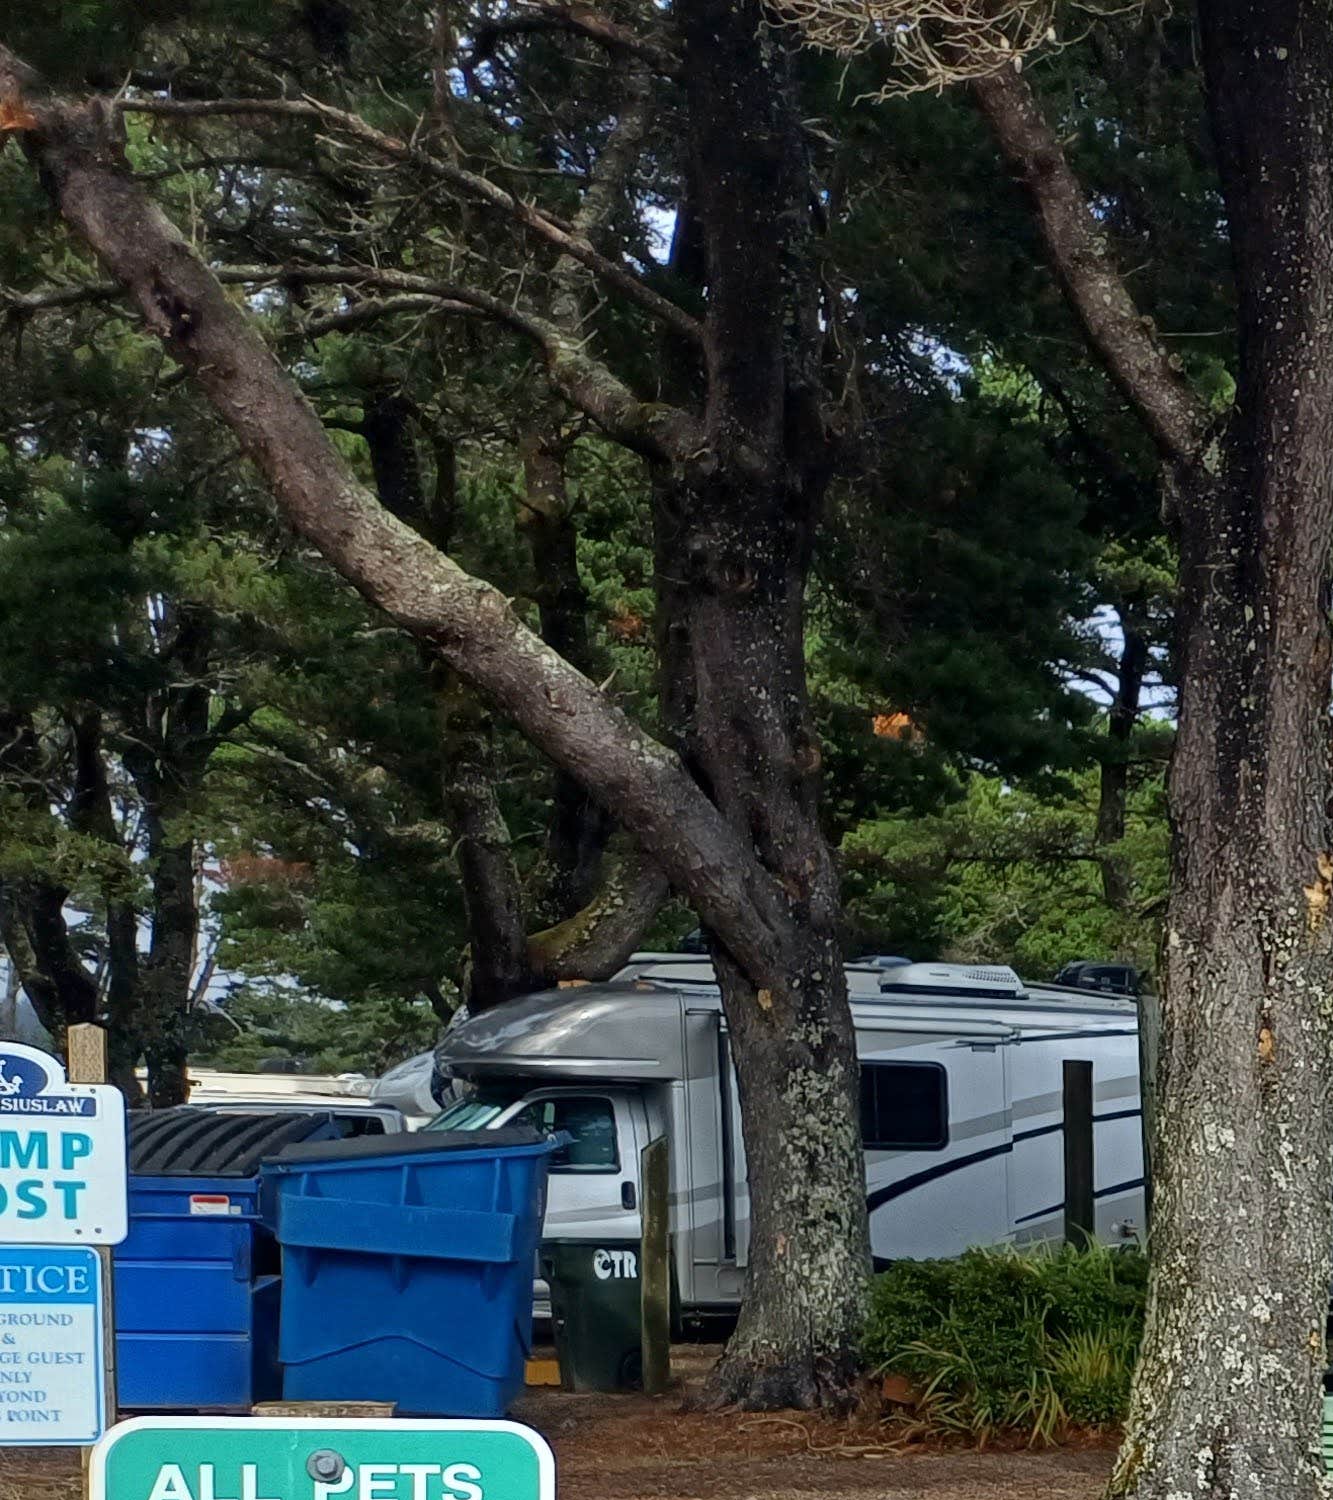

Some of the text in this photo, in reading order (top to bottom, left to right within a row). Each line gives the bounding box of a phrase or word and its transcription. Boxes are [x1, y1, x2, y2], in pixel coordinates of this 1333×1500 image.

[0, 1179, 86, 1219] ST
[28, 1352, 85, 1365] GUEST
[7, 1410, 62, 1422] POINT
